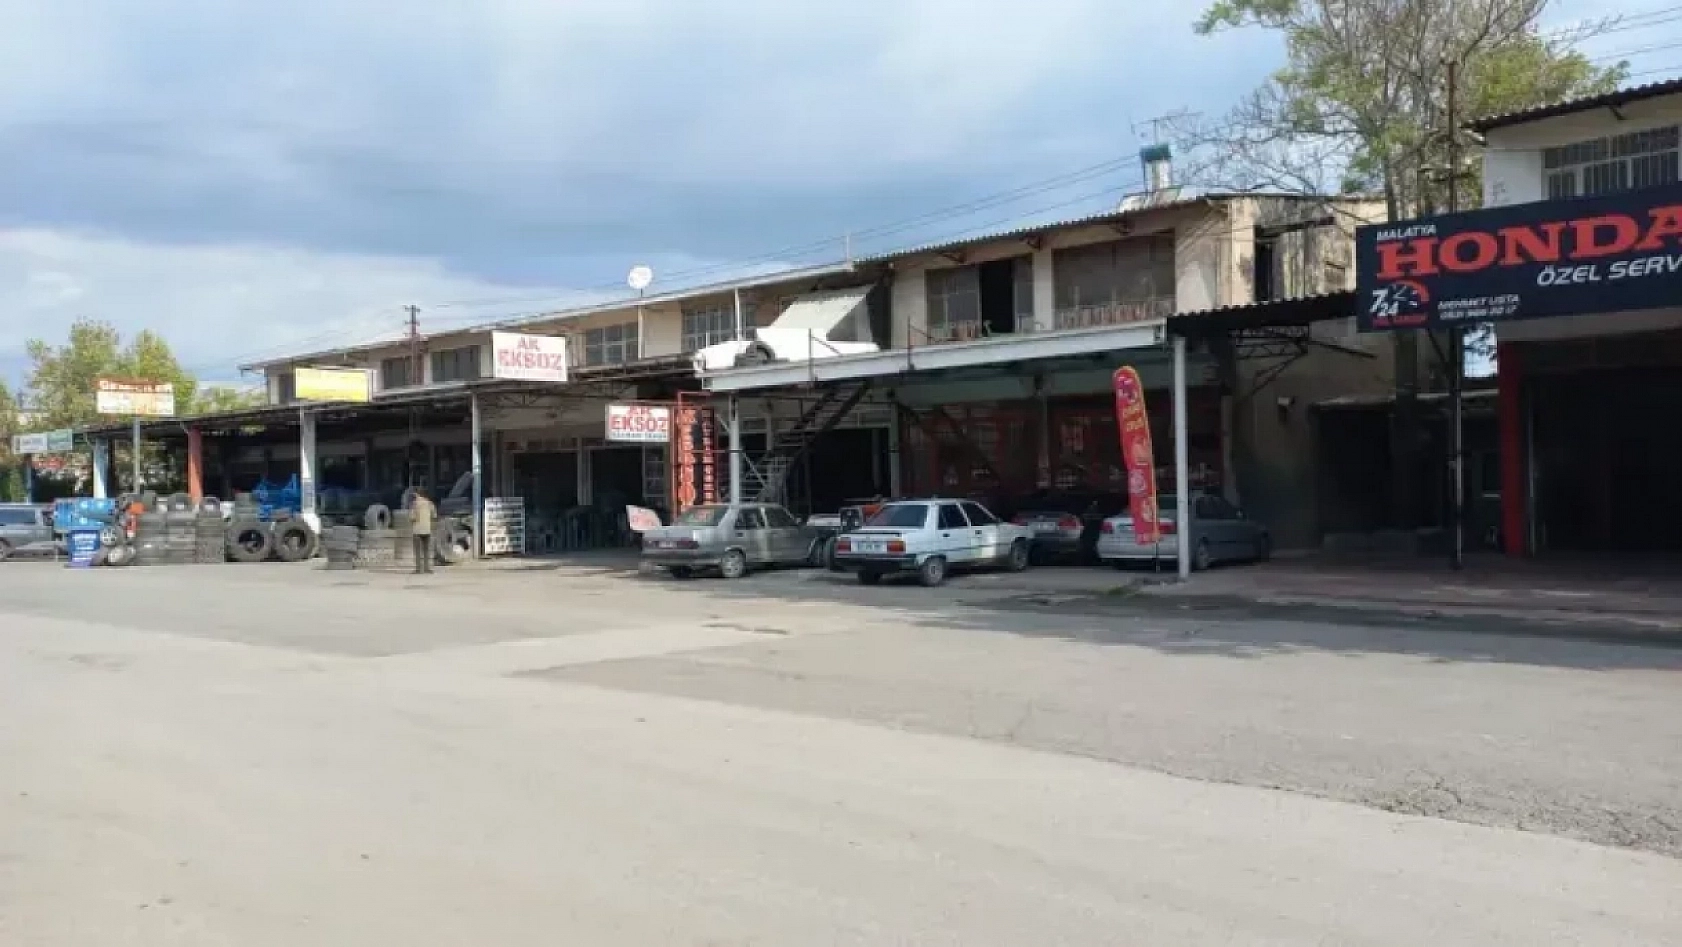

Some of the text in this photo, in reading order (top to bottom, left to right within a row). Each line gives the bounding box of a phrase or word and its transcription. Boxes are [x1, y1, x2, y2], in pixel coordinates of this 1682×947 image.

[1376, 225, 1436, 241] MALATYA
[1376, 205, 1682, 280] HONDA
[1537, 264, 1602, 287] ÖZEL
[515, 336, 541, 351] AK
[496, 348, 563, 371] EKSOZ
[625, 404, 650, 417] AK
[610, 416, 669, 433] EKSOZ
